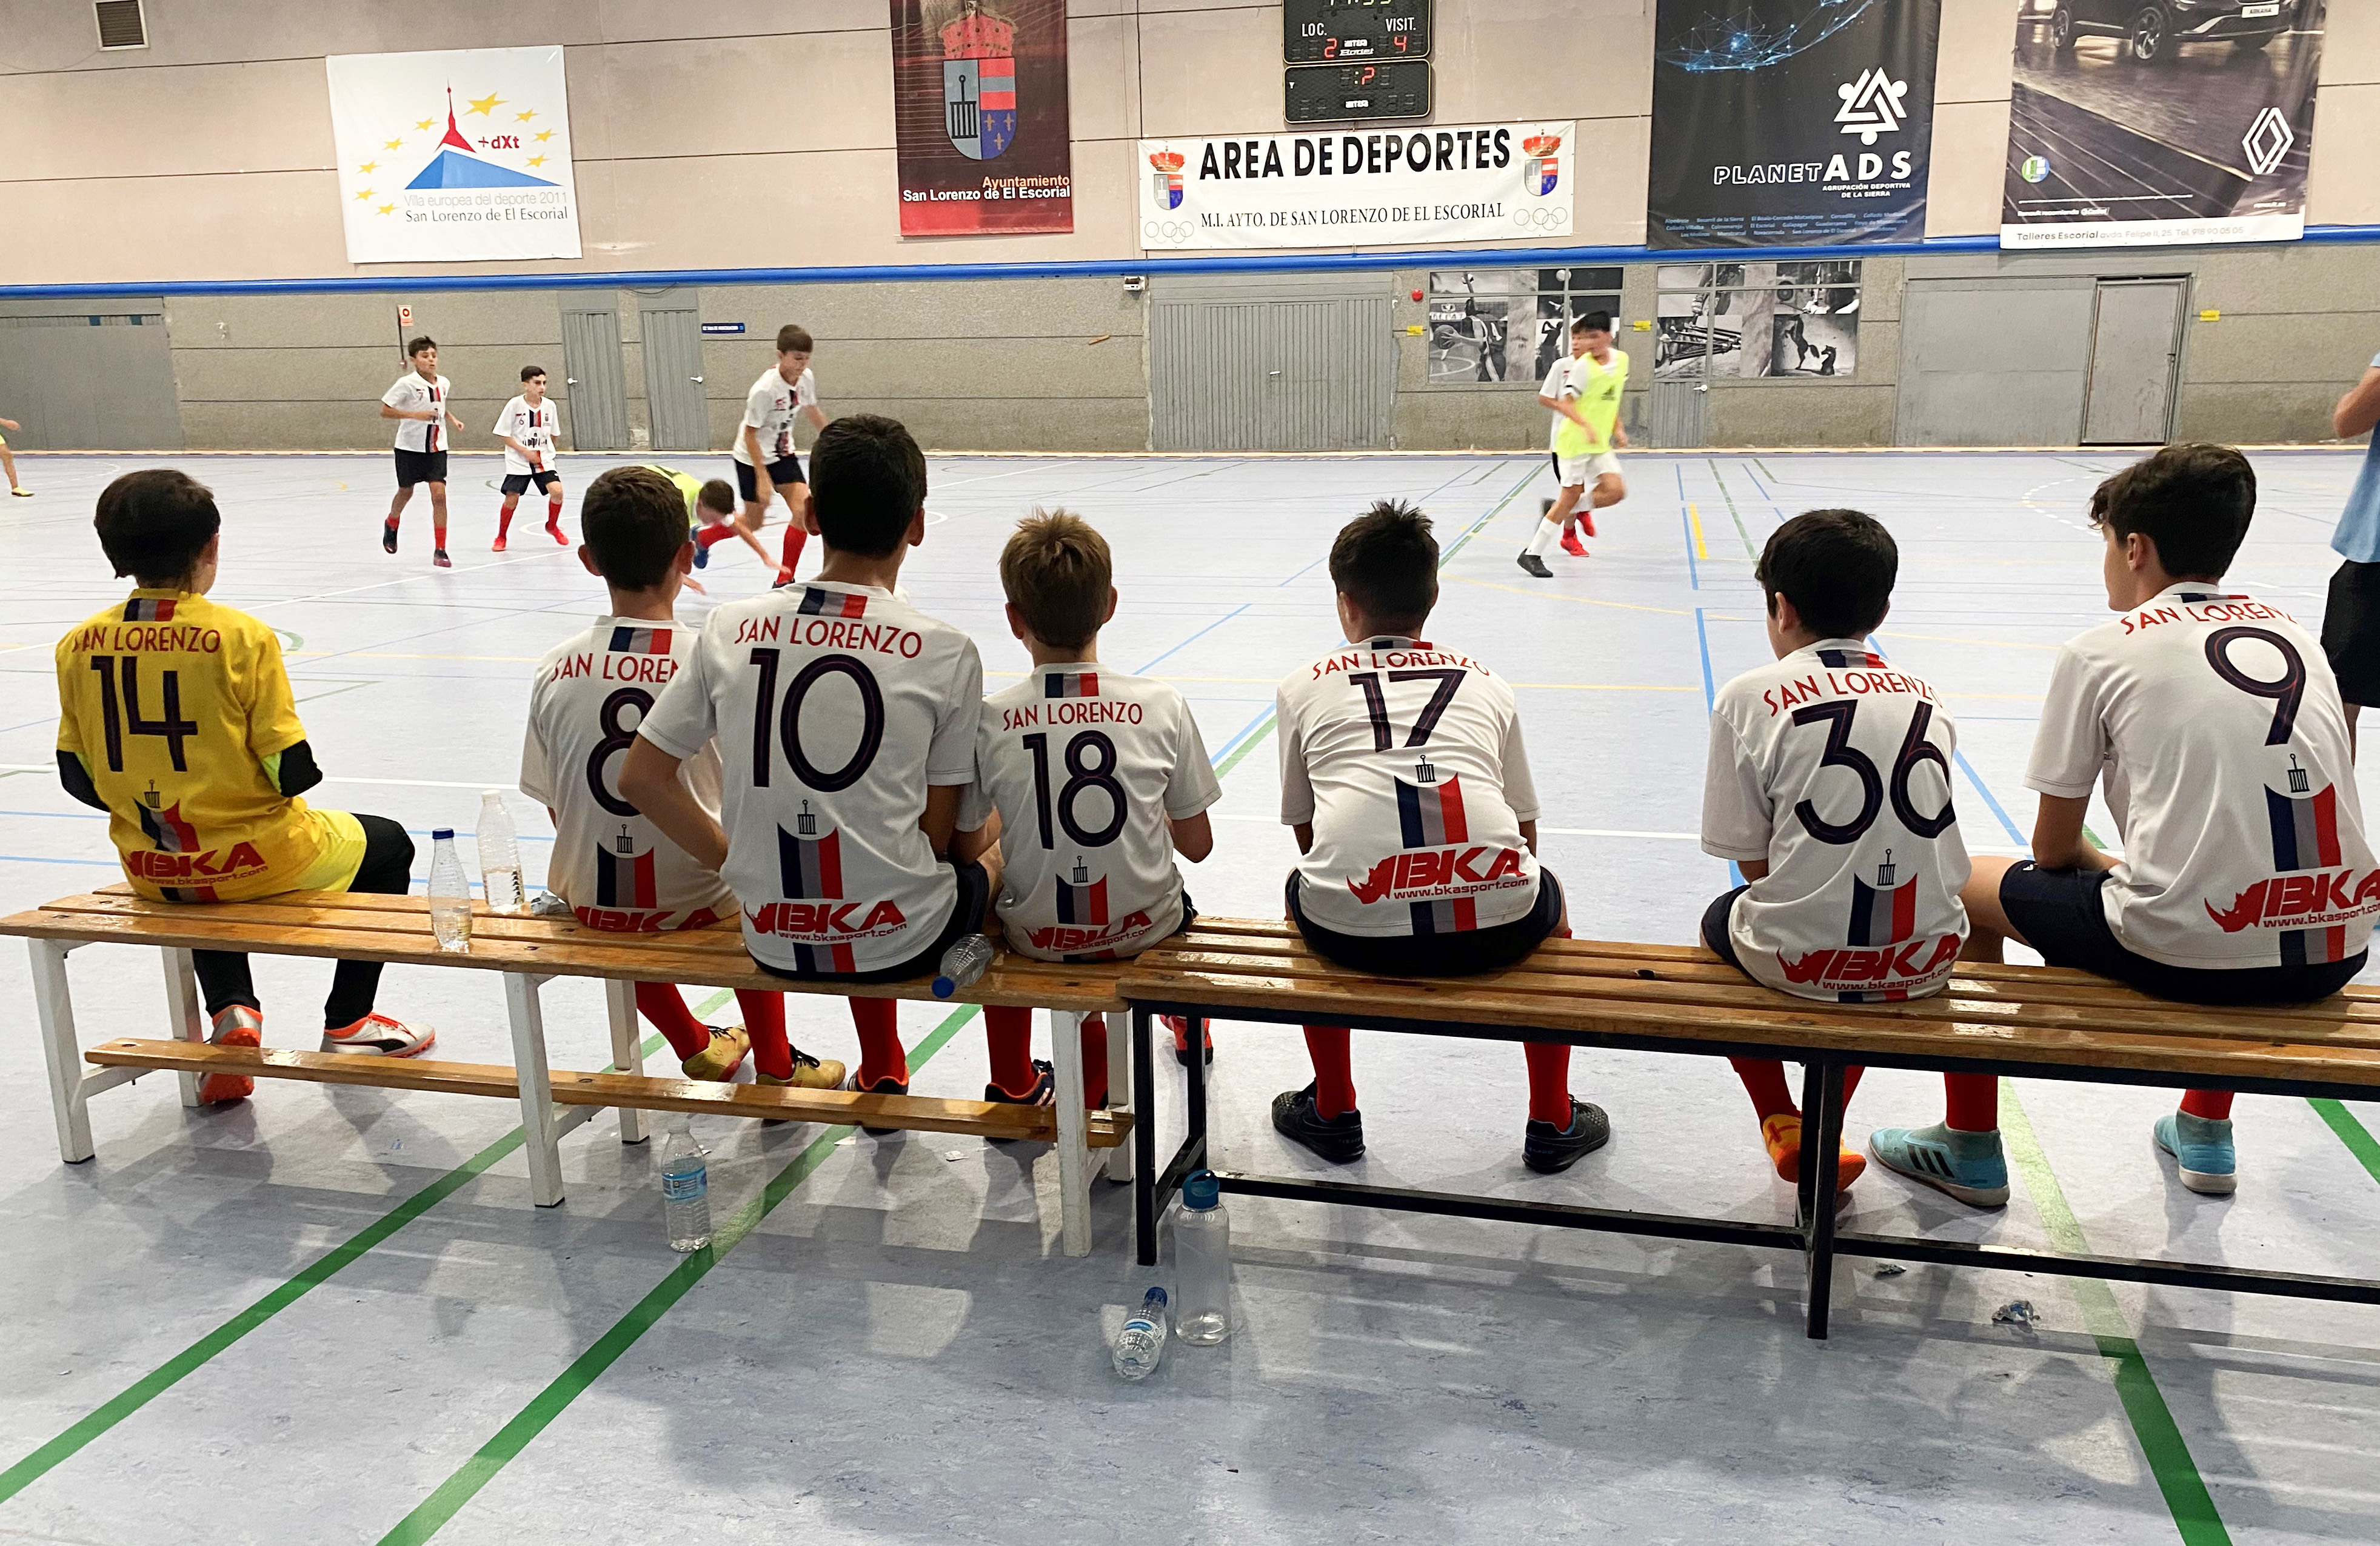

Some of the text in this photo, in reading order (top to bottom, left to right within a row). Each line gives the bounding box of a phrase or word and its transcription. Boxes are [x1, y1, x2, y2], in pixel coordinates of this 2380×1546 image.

[1302, 17, 1416, 37] LOC. VISIT.
[1324, 38, 1337, 58] 2
[1394, 35, 1407, 53] 4
[1199, 128, 1510, 180] AREA DE DEPORTES
[903, 185, 1071, 202] San Lorenzo de El Escorial
[982, 175, 1071, 190] Ayuntamiento
[1822, 183, 1869, 192] AGRUPACIÓN
[404, 192, 567, 208] Villa europea del deporte 2011
[406, 206, 568, 223] San Lorenzo de El Escorial
[1201, 202, 1505, 227] M.I. AYTO. DE SAN LORENZO DE EL ESCORIAL
[2058, 230, 2099, 240] Escorial
[2125, 230, 2151, 239] Felipe
[2120, 606, 2182, 636] SAN
[72, 626, 221, 654] SAN LORENZO
[734, 616, 923, 659] SAN LORENZO
[550, 652, 593, 682] SAN
[1312, 651, 1491, 681] SAN LORENZO
[1763, 674, 1819, 717] SAN
[2204, 626, 2306, 747] 9
[90, 655, 198, 772] 14
[749, 647, 885, 793] 10
[1003, 701, 1143, 731] SAN LORENZO
[1348, 668, 1469, 753] 17
[586, 687, 656, 817] 8
[1791, 699, 1957, 845] 36
[1022, 730, 1128, 850] 18
[144, 841, 266, 877] BKA
[1394, 847, 1527, 890] BKA
[148, 865, 269, 886] www.bkasport.com
[1394, 877, 1529, 900] www.bkasport.com
[2263, 868, 2380, 918] BKA
[777, 899, 908, 934] BKA
[1052, 910, 1152, 949] BKA
[2263, 903, 2380, 928] www.bkasport.co
[778, 922, 908, 944] www.bkasport.com
[1052, 925, 1154, 952] www.bkasport.com
[1823, 933, 1961, 981] BKA
